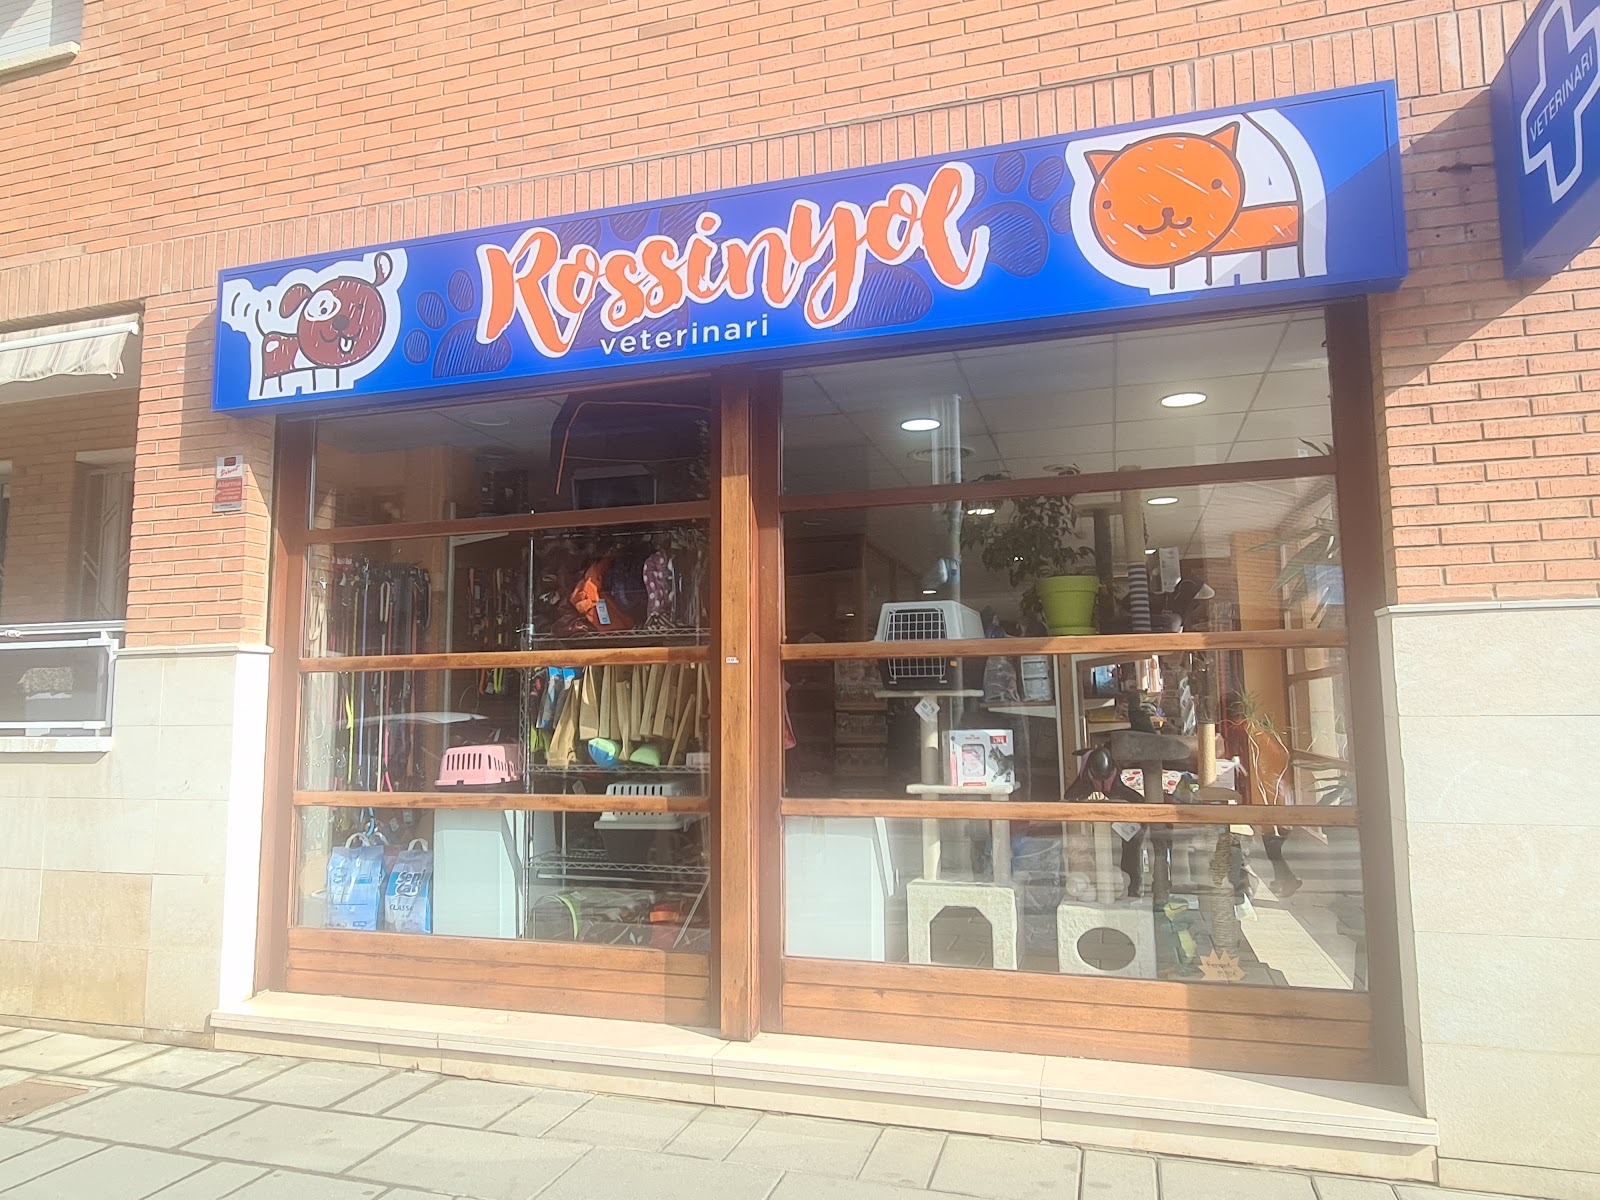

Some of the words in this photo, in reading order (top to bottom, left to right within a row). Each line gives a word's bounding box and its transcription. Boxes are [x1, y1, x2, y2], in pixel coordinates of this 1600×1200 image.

[1530, 46, 1594, 142] VETERINARI
[482, 164, 979, 354] Rossinyol
[600, 314, 769, 355] veterinari
